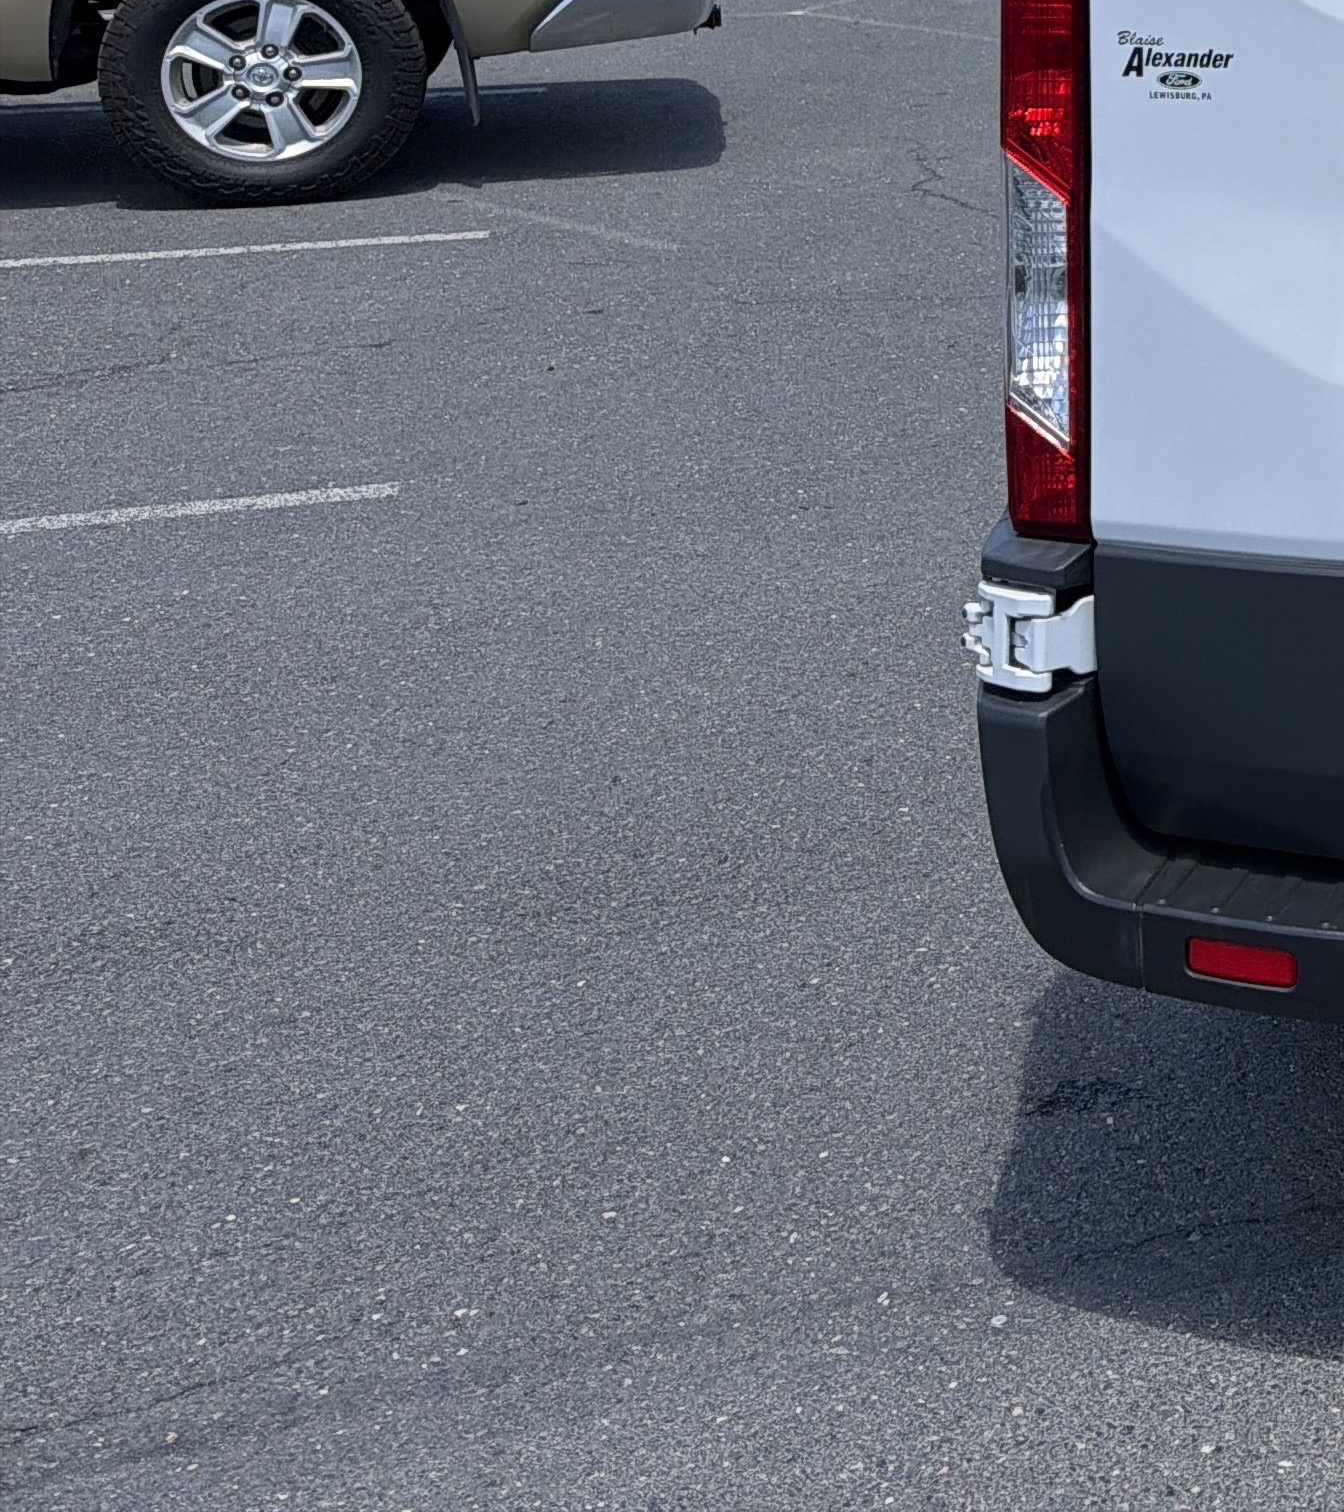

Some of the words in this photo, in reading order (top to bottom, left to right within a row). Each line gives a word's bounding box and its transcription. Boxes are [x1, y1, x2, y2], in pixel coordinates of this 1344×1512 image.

[1117, 30, 1164, 47] Blaise
[1122, 47, 1234, 77] Alexander
[1165, 73, 1193, 86] Ford
[1149, 91, 1200, 101] LEWISBURG,
[1201, 92, 1213, 101] PA
